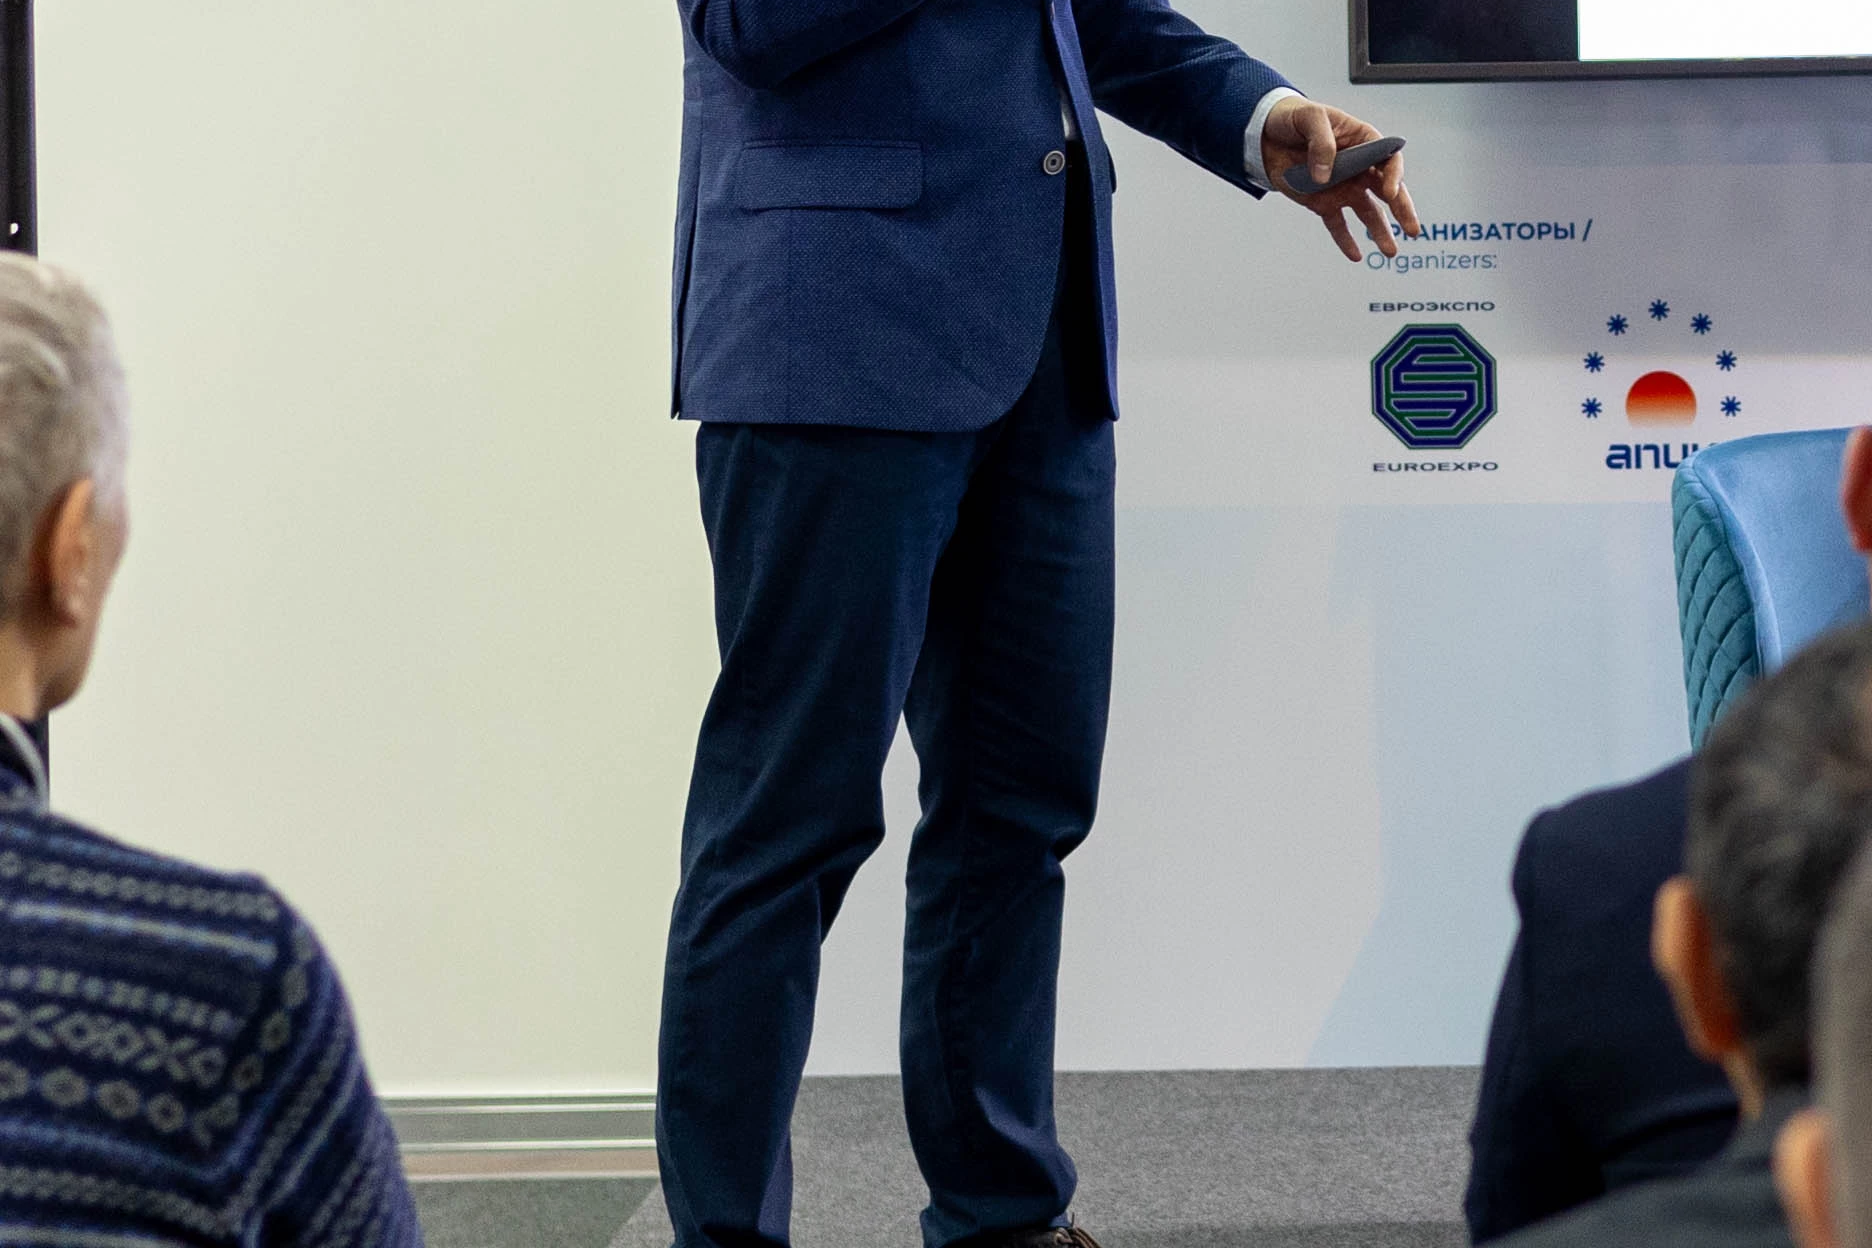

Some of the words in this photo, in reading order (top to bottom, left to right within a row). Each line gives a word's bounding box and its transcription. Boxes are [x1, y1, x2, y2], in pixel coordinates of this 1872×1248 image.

[1366, 222, 1576, 241] РАНИЗАТОРЫ
[1369, 301, 1497, 313] ЕВРОЭКСПО
[1372, 462, 1499, 472] EUROEXPO
